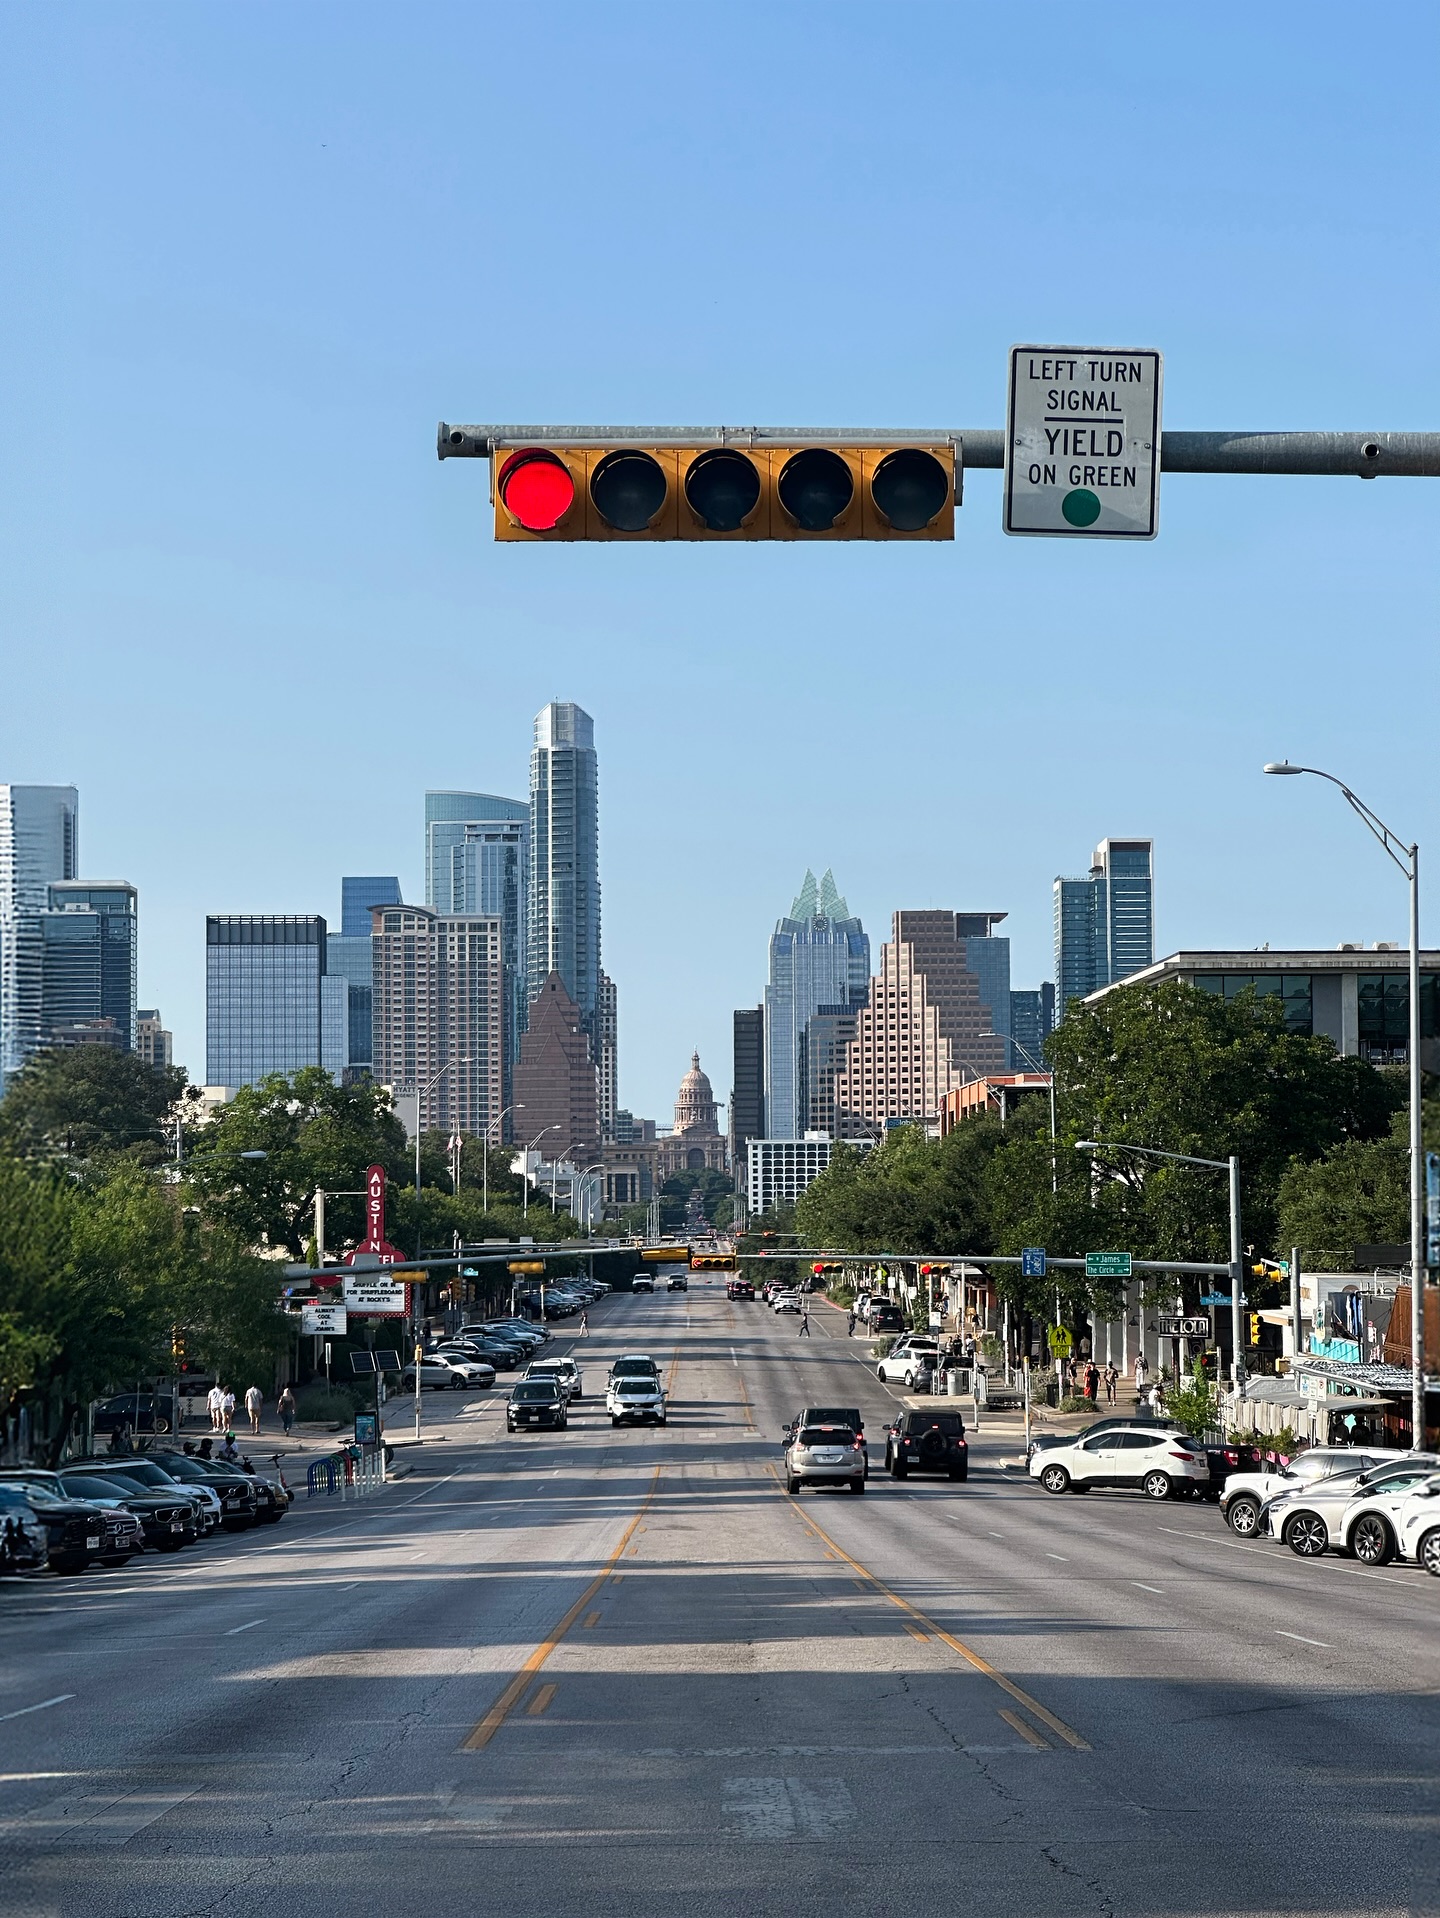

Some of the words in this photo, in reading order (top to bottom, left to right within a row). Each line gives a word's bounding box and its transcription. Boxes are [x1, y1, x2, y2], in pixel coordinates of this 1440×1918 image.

[1029, 359, 1077, 381] LEFT
[1088, 361, 1142, 383] TURN
[1046, 389, 1122, 412] SIGNAL
[1044, 428, 1123, 457] YIELD
[1028, 463, 1056, 485] ON
[1069, 465, 1136, 487] GREEN
[370, 1172, 381, 1252] AUSTIN
[1087, 1266, 1097, 1274] The
[1099, 1266, 1115, 1274] Circle
[1100, 1255, 1120, 1263] James
[1160, 1320, 1179, 1334] THE
[1180, 1320, 1206, 1334] LOLA
